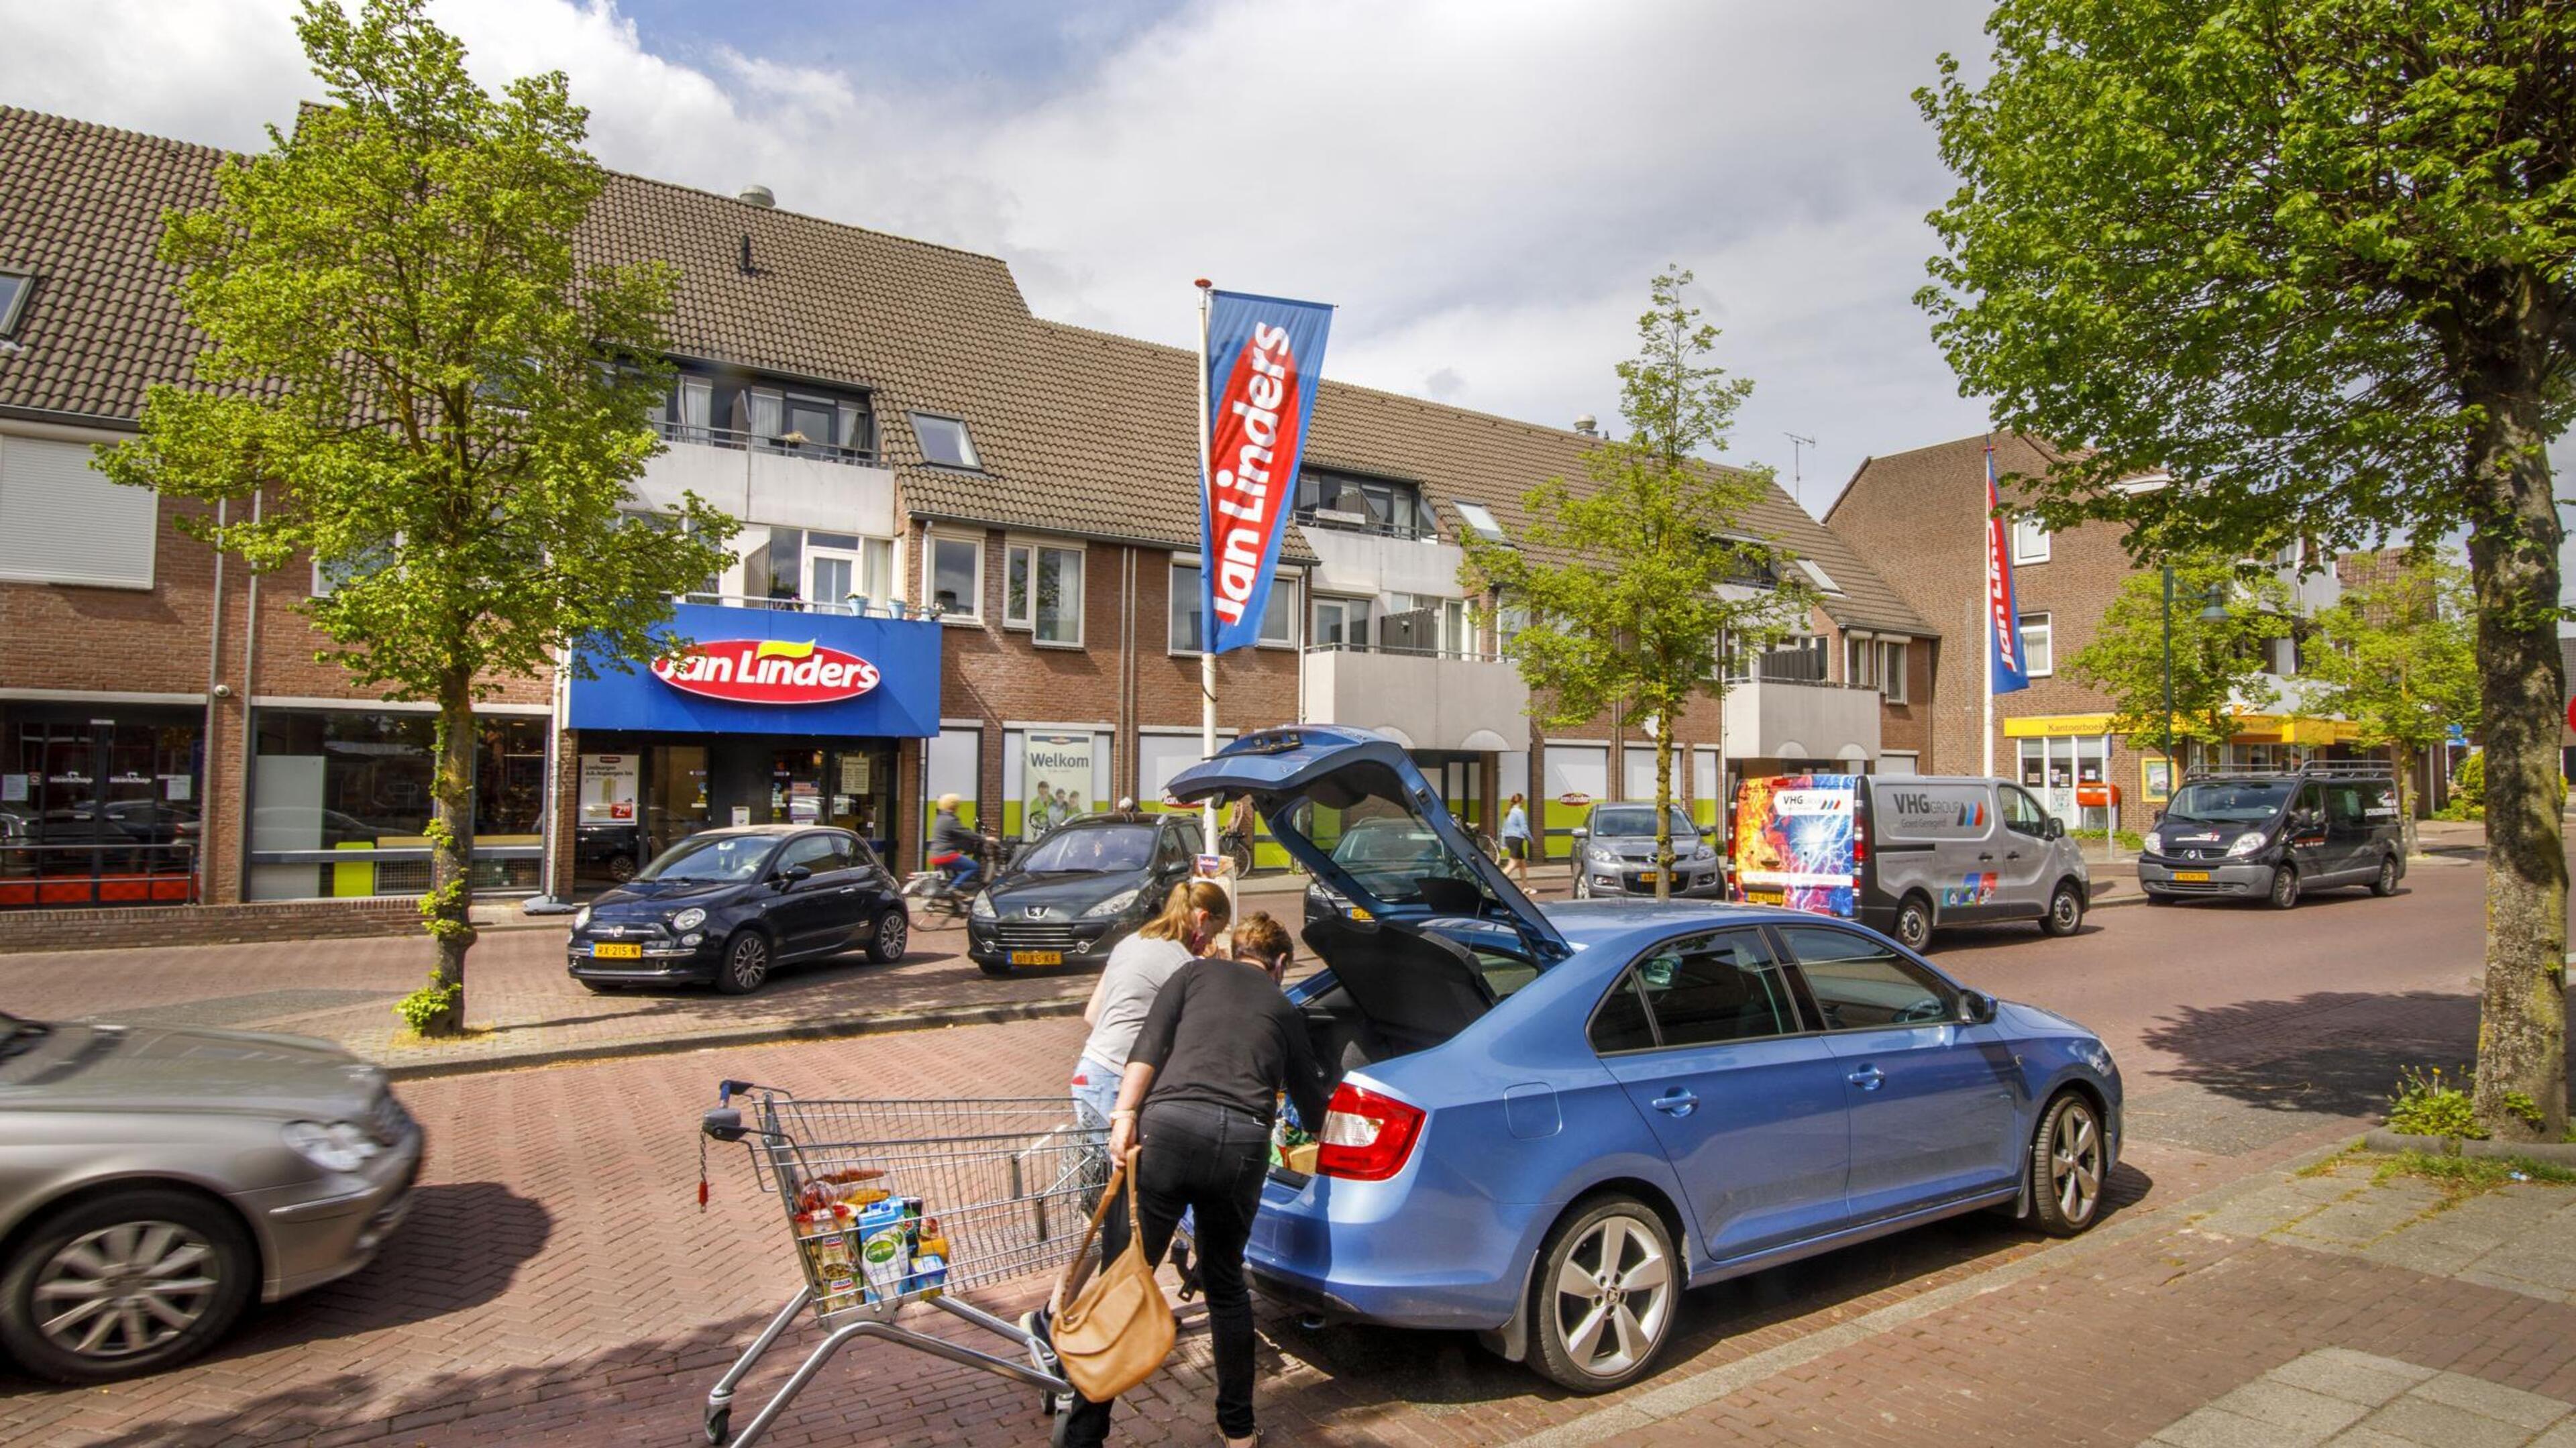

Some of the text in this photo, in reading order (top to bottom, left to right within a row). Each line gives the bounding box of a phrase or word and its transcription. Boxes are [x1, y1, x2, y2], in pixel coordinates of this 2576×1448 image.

[1214, 321, 1289, 626] Jan Linders
[736, 650, 879, 688] Linders
[2048, 723, 2105, 734] Kantoorboek
[1030, 753, 1089, 767] Welkom
[1783, 796, 1803, 804] VHG
[1893, 793, 1930, 814] VHG
